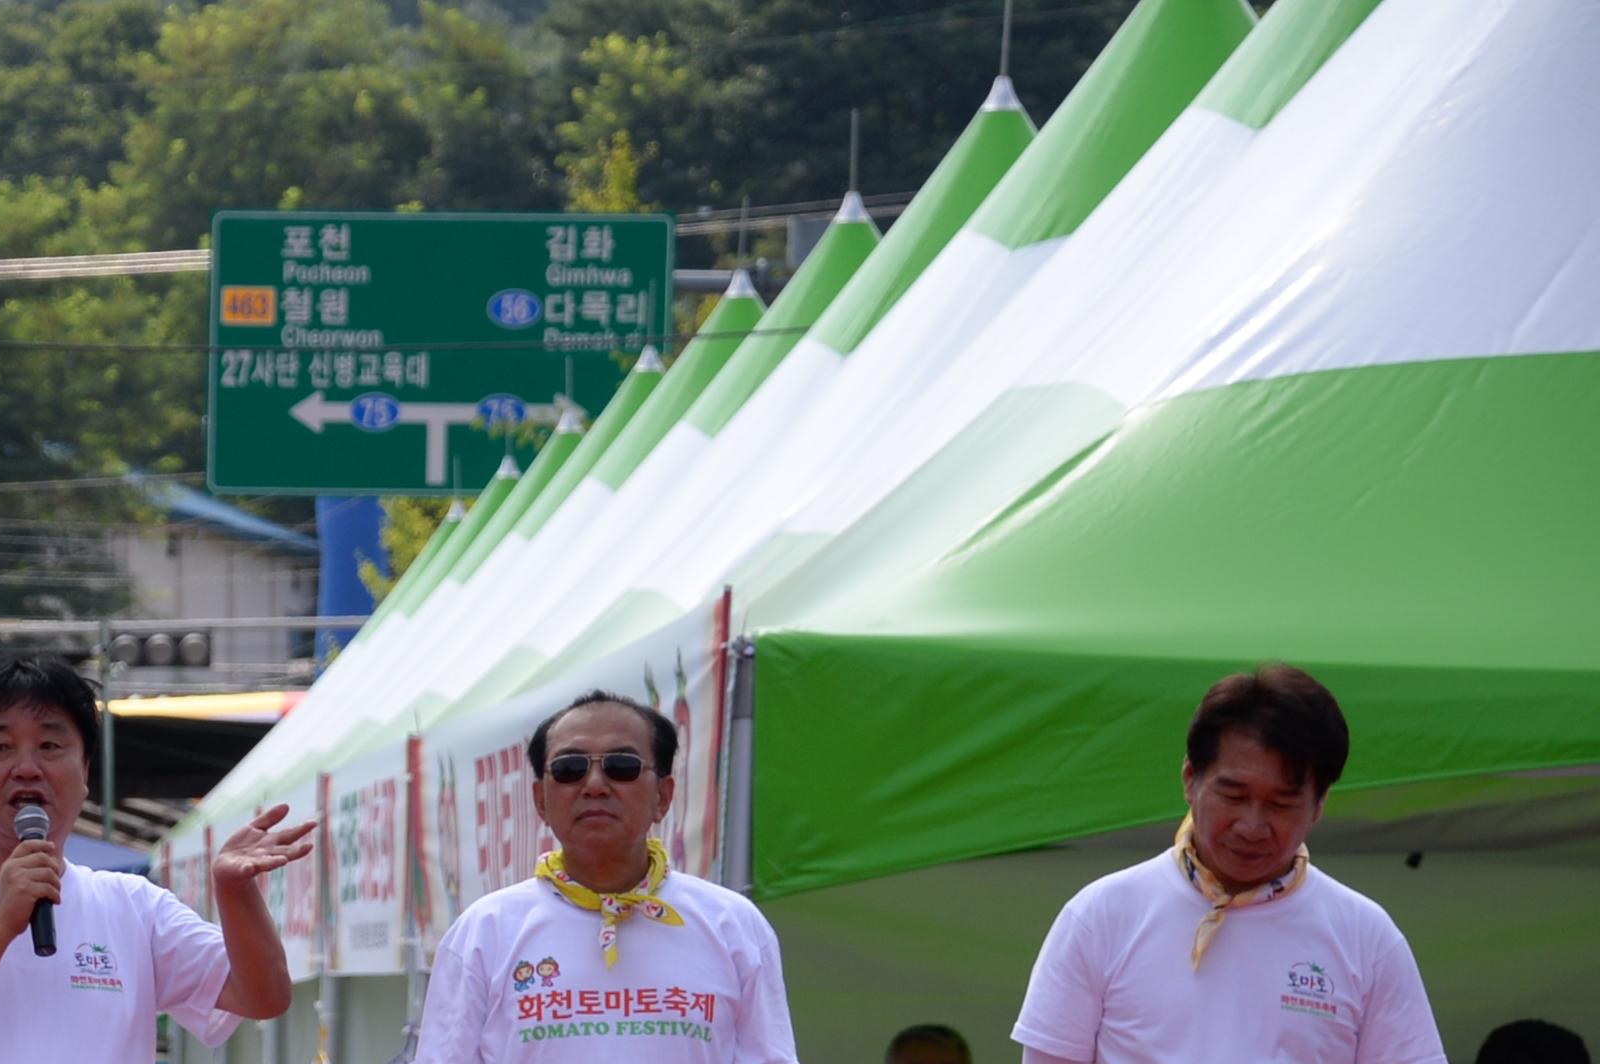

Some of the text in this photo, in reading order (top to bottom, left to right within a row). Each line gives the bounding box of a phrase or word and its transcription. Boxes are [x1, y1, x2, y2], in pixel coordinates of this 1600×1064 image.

[281, 223, 351, 260] 포천
[546, 224, 616, 262] 김화
[283, 260, 371, 285] Pocheon
[545, 263, 633, 287] Gimhwa
[281, 287, 349, 325] 철원
[501, 293, 532, 324] 56
[544, 289, 647, 328] 다목리
[281, 324, 383, 348] Cheorwon
[221, 350, 429, 389] 27사단 신병교육대
[358, 398, 390, 428] 75
[1287, 971, 1328, 993] 토마토
[518, 986, 716, 1024] 화천토마토축제
[519, 1020, 712, 1043] TOMATO FESTIVAL
